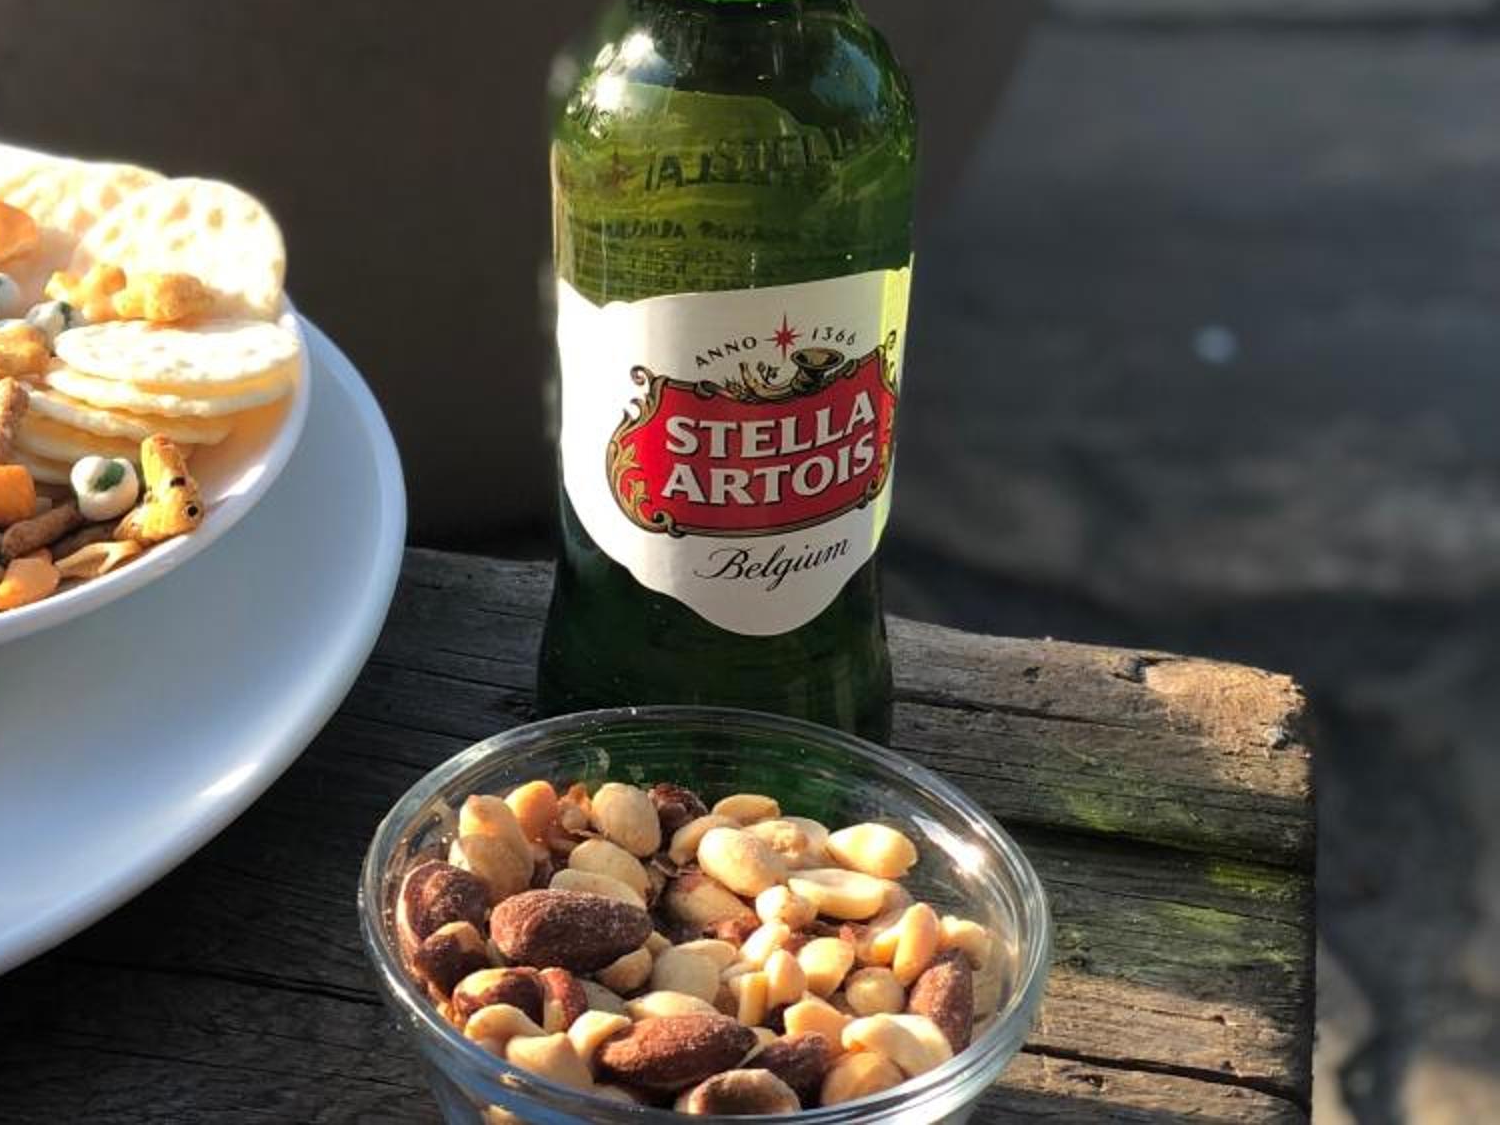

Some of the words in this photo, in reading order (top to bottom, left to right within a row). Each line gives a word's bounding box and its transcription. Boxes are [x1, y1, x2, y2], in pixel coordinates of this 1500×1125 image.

[694, 336, 758, 369] ANNO
[810, 327, 857, 347] 1366
[665, 390, 877, 459] STELLA
[660, 432, 877, 506] ARTOIS
[692, 537, 852, 593] Belgium
